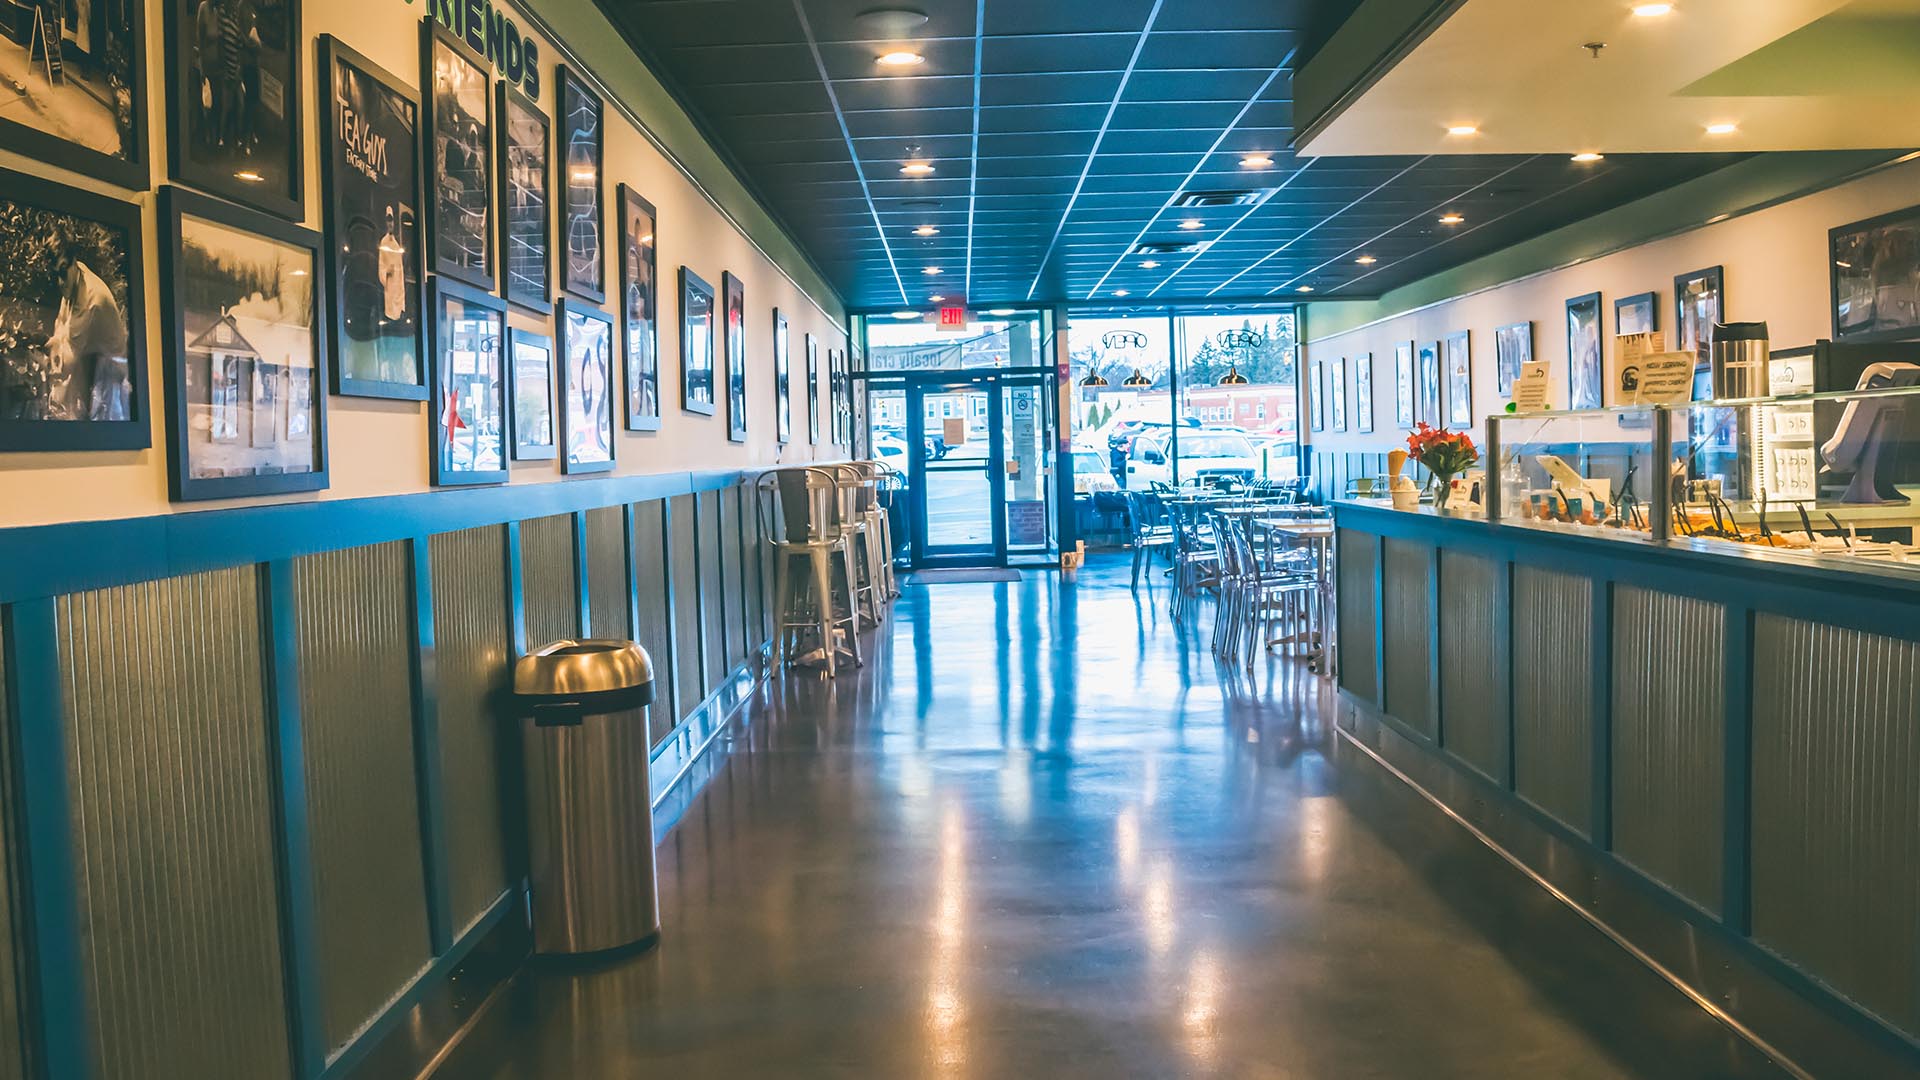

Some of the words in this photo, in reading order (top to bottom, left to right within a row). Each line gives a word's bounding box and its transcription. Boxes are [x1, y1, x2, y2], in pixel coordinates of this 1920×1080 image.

[336, 95, 361, 153] TEA
[363, 123, 387, 176] GUYS
[941, 307, 963, 324] EXIT
